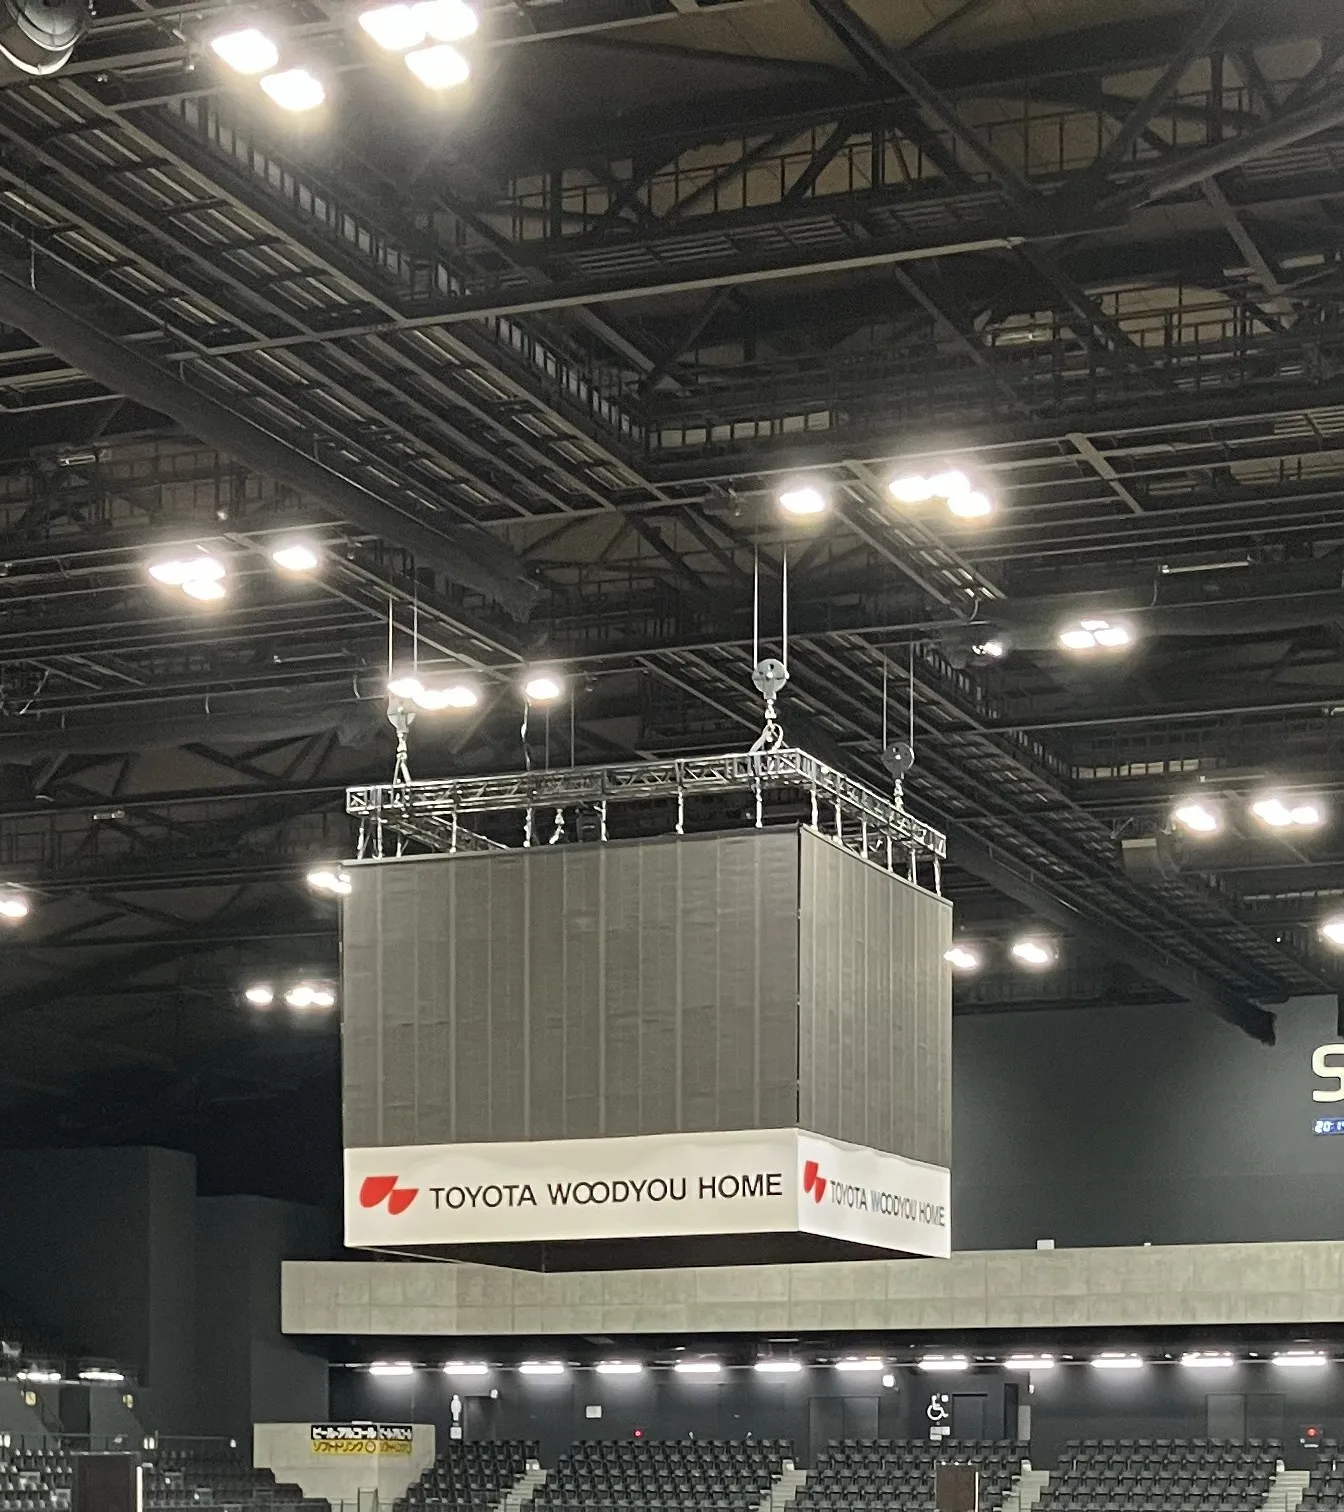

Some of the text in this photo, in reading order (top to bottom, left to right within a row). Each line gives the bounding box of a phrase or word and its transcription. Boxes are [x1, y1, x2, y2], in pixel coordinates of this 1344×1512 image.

[429, 1173, 783, 1210] TOYOTA WOODYOU HOME
[830, 1180, 945, 1227] TOYOTA WOODYOU HOME
